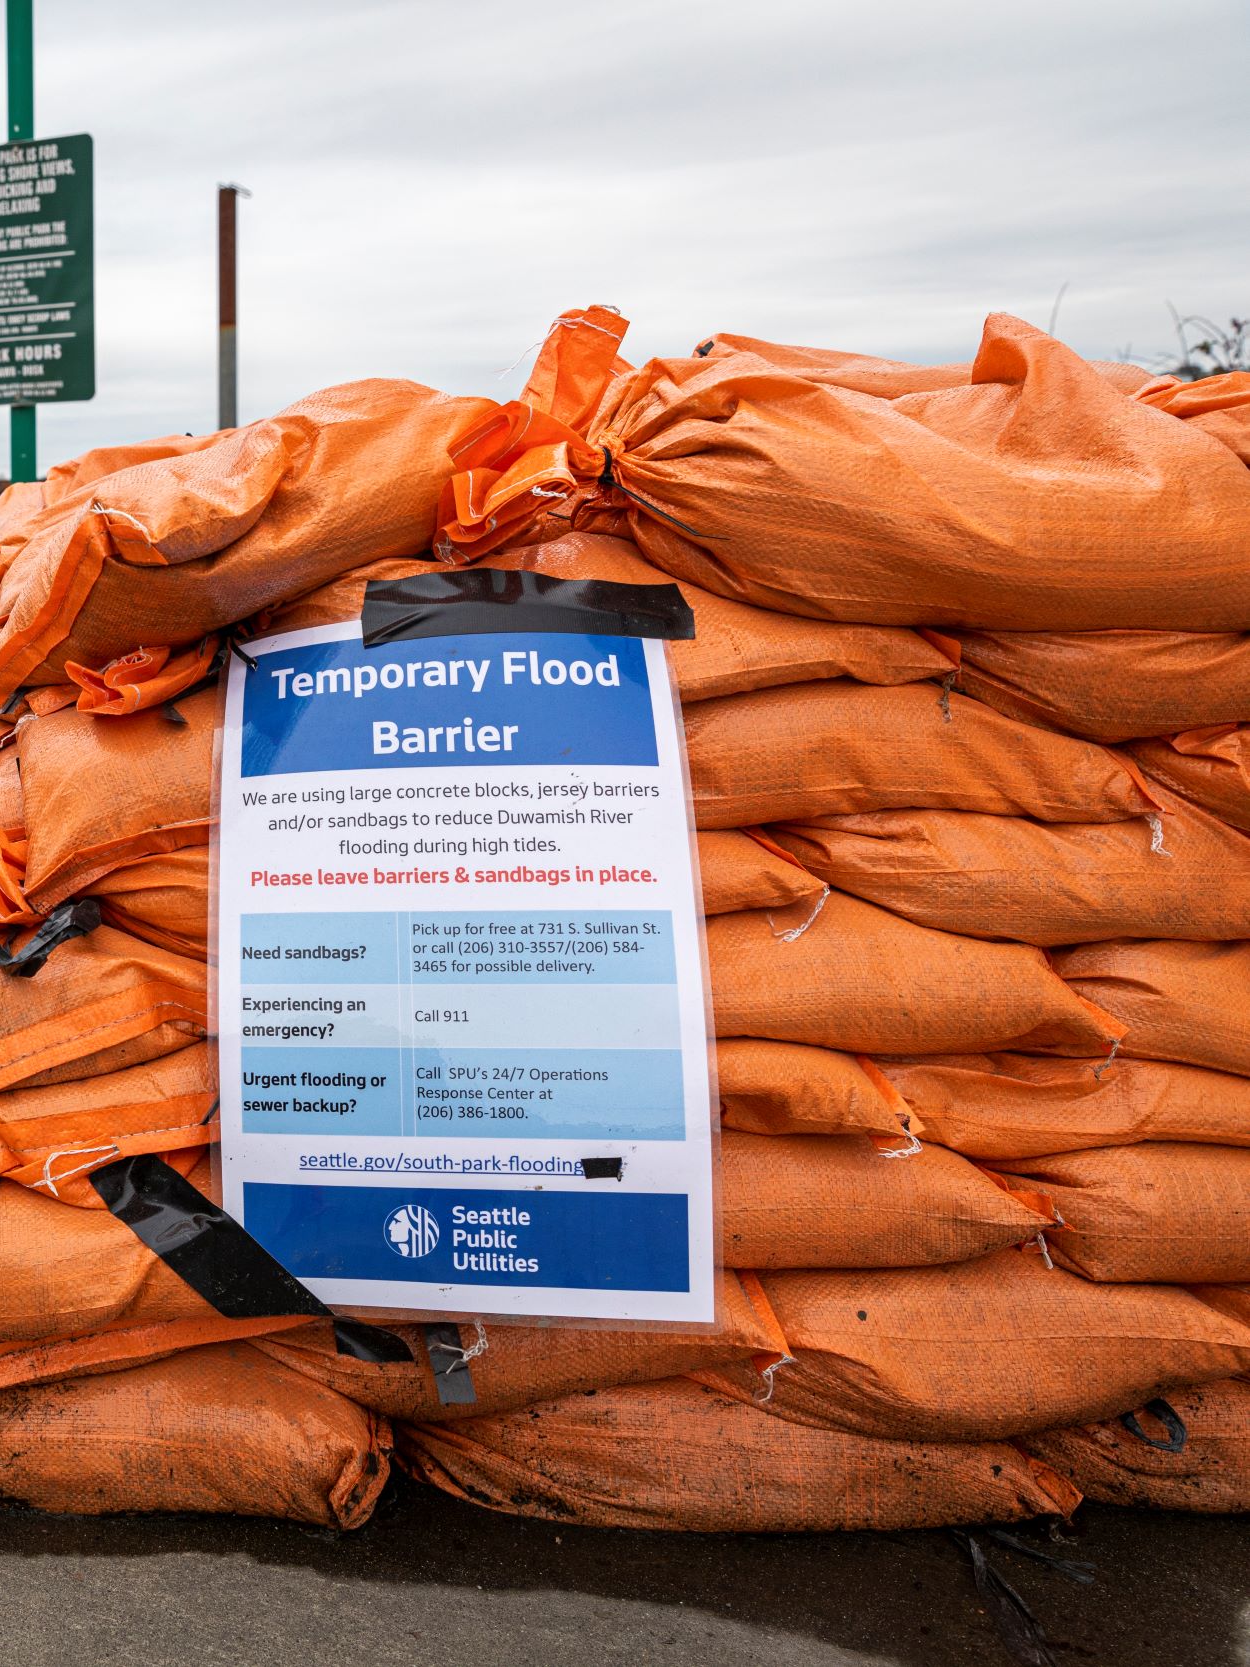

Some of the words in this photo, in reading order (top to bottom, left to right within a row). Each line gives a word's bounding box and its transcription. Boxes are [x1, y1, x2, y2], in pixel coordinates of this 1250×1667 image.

[0, 148, 24, 165] PARK
[27, 148, 36, 162] IS
[39, 144, 58, 160] FOR
[8, 164, 39, 181] SHORE
[36, 179, 56, 194] AND
[15, 344, 62, 361] HOURS
[22, 365, 44, 376] DUSK
[271, 658, 490, 699] Temporary
[503, 651, 620, 686] Flood
[373, 717, 518, 754] Barrier
[243, 792, 266, 806] We
[272, 793, 297, 804] are
[302, 788, 344, 803] using
[350, 786, 391, 802] large
[397, 785, 470, 799] concrete
[476, 782, 533, 798] blocks,
[538, 782, 588, 800] jersey
[594, 782, 659, 797] barriers
[269, 815, 323, 832] and/or
[328, 813, 407, 829] sandbags
[412, 813, 429, 825] to
[435, 810, 492, 825] reduce
[498, 809, 585, 824] Duwamish
[591, 810, 633, 823] River
[339, 840, 408, 856] flooding
[414, 839, 467, 855] during
[473, 838, 508, 855] high
[514, 837, 560, 851] tides.
[252, 871, 312, 886] Please
[318, 869, 368, 885] leave
[374, 868, 449, 884] barriers
[455, 867, 469, 883] &
[475, 866, 570, 885] sandbags
[576, 866, 593, 882] in
[599, 866, 657, 885] place.
[413, 923, 439, 935] Pick
[444, 927, 460, 937] up
[465, 923, 484, 934] for
[489, 923, 516, 934] free
[521, 924, 534, 934] at
[538, 923, 564, 934] 731
[569, 923, 579, 934] S.
[585, 922, 638, 934] Sullivan
[643, 923, 660, 934] St.
[243, 946, 280, 959] Need
[285, 946, 366, 961] sandbags?
[413, 945, 427, 953] or
[432, 942, 453, 953] call
[459, 941, 493, 956] (206)
[499, 941, 608, 955] 310-3557/(206)
[613, 942, 644, 952] 584-
[414, 961, 447, 972] 3465
[451, 960, 471, 972] for
[476, 960, 531, 974] possible
[537, 960, 594, 974] delivery.
[243, 998, 342, 1014] Experiencing
[347, 1001, 365, 1011] an
[415, 1010, 439, 1022] Call
[444, 1011, 469, 1022] 911
[243, 1023, 334, 1039] emergency?
[244, 1072, 296, 1088] Urgent
[301, 1072, 366, 1089] flooding
[371, 1077, 386, 1087] or
[417, 1067, 440, 1079] Call
[493, 1067, 524, 1082] 24/7
[530, 1069, 608, 1083] Operations
[418, 1087, 482, 1100] Response
[488, 1088, 534, 1099] Center
[539, 1089, 553, 1099] at
[244, 1101, 288, 1111] sewer
[293, 1098, 356, 1115] backup?
[418, 1105, 452, 1120] (206)
[458, 1106, 528, 1119] 386-1800.
[452, 1206, 530, 1225] Seattle
[453, 1229, 517, 1248] Public
[454, 1252, 538, 1272] Utilities
